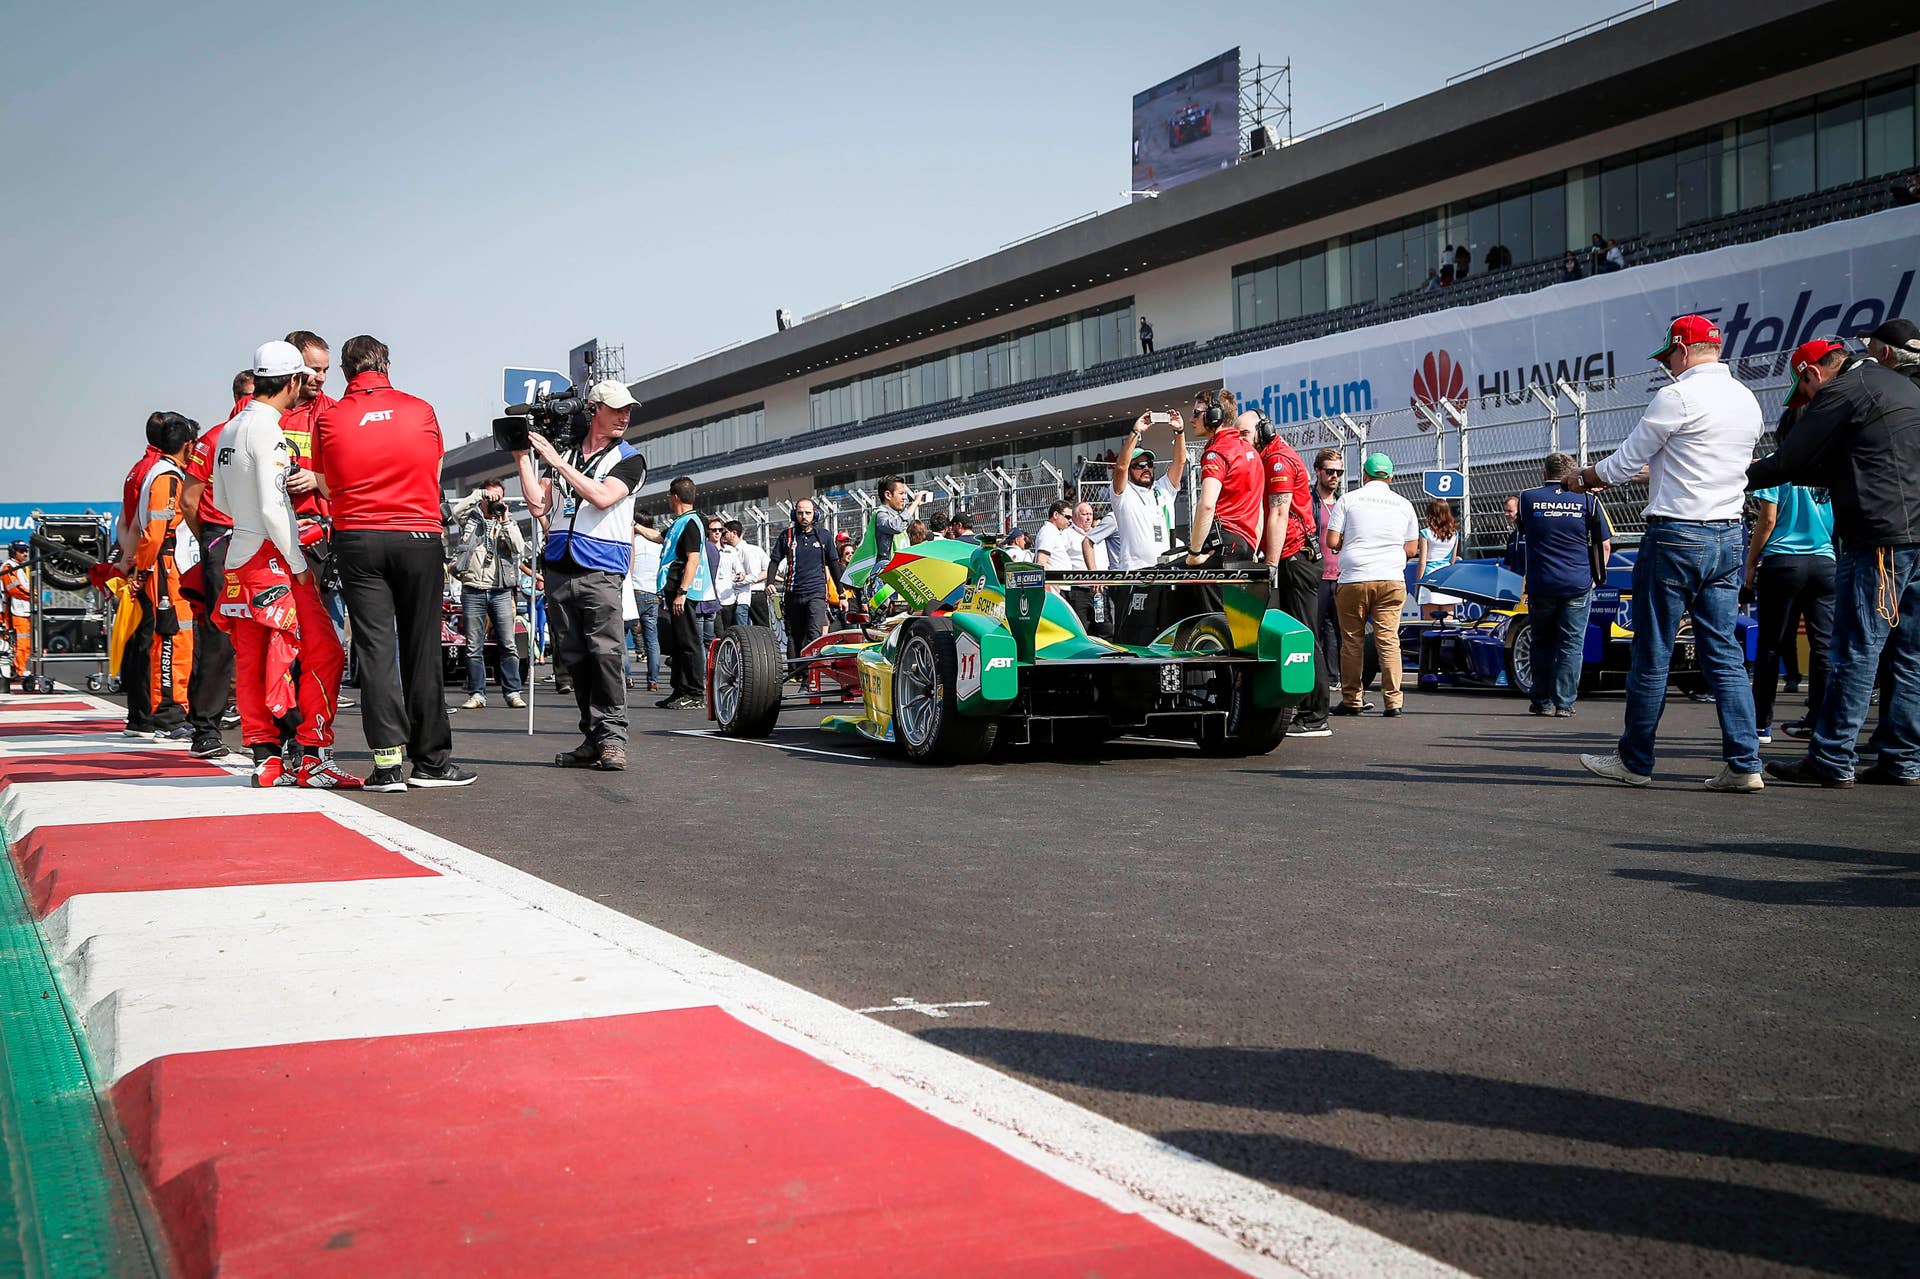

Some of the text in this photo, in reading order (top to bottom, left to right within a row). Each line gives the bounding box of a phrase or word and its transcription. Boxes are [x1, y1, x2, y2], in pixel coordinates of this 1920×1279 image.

[1720, 270, 1916, 381] telcel
[1478, 350, 1616, 410] HUAWEI
[523, 378, 552, 405] 11
[359, 409, 394, 426] ABT
[218, 447, 236, 468] ABT
[1438, 475, 1452, 492] 8
[1533, 502, 1583, 511] RENAULT
[0, 515, 36, 530] ULA
[1128, 593, 1148, 615] ABT
[162, 639, 172, 688] MARSHAL
[961, 652, 975, 681] 11
[984, 657, 1014, 672] ABT
[1284, 652, 1312, 666] ABT
